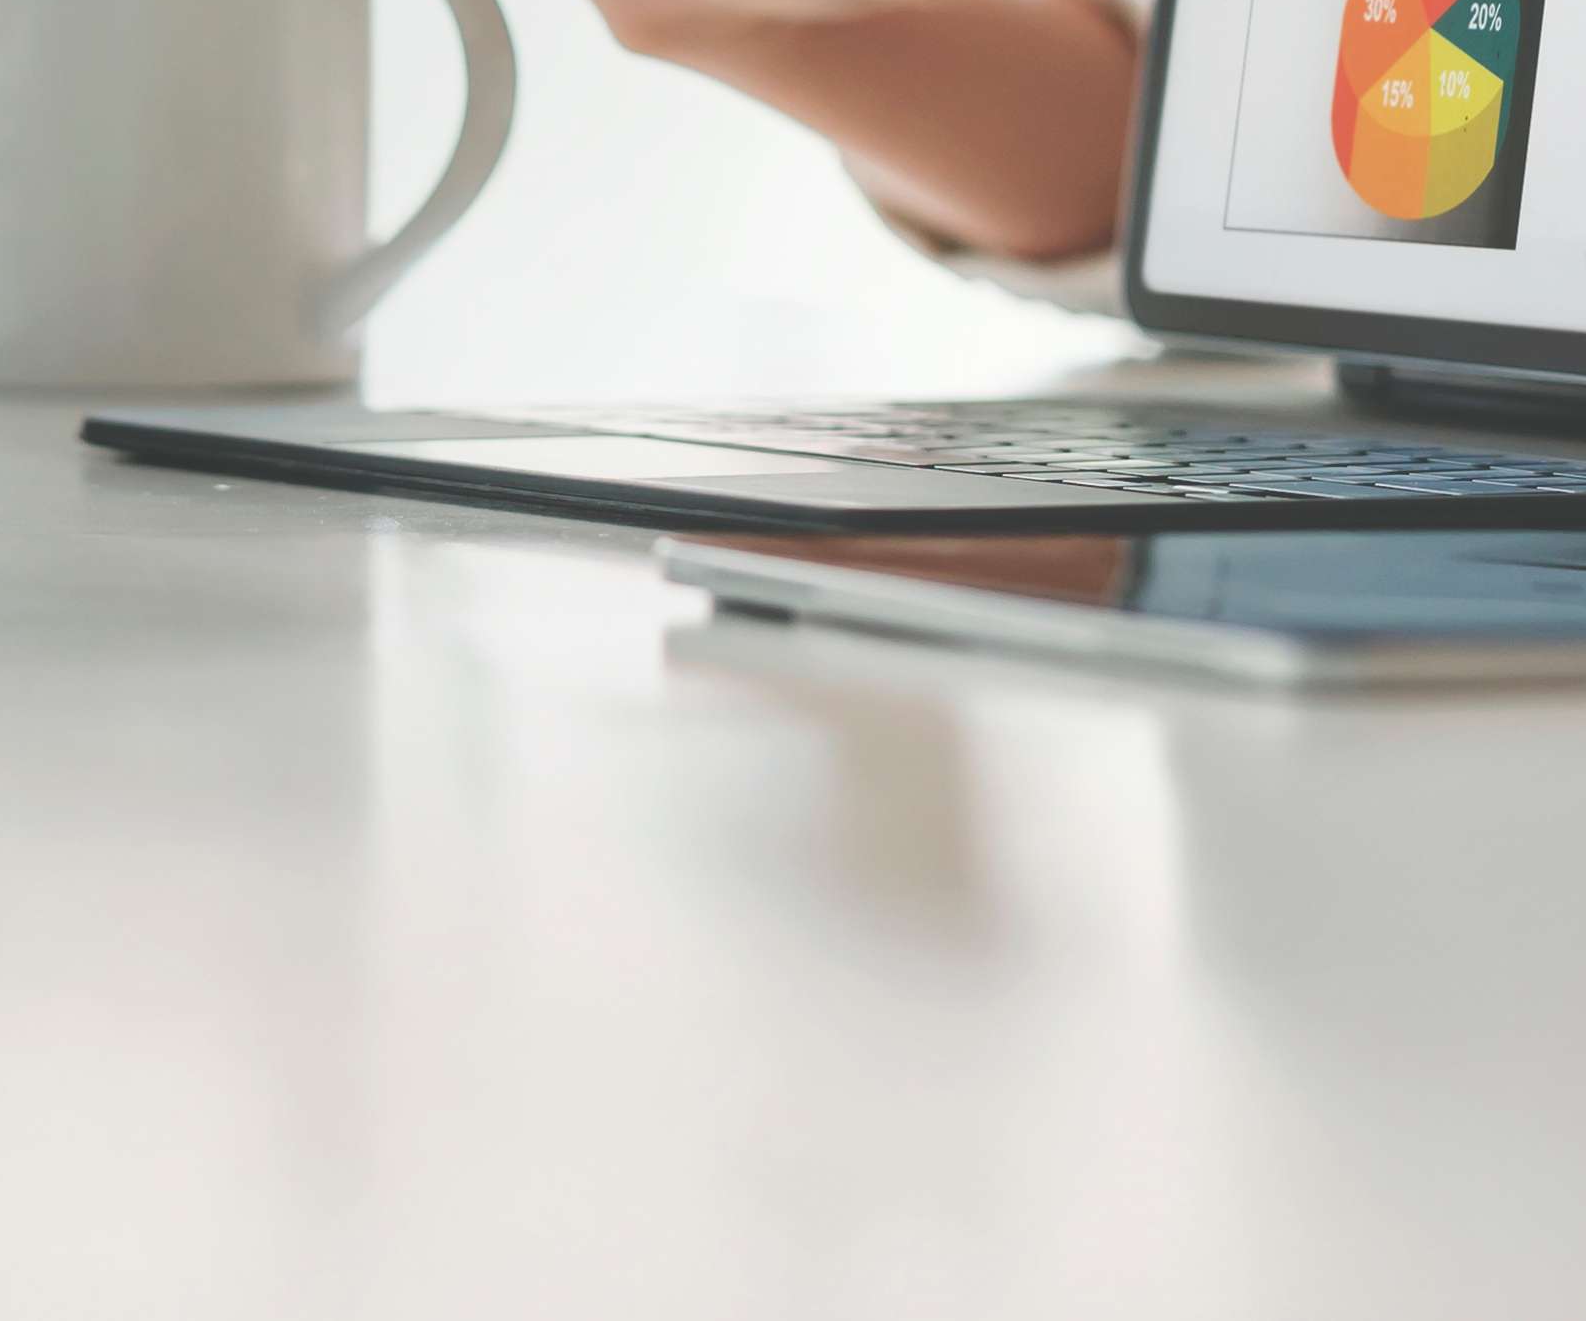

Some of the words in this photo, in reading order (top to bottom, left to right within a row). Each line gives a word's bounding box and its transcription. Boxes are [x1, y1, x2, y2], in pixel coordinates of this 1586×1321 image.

[1468, 2, 1502, 31] 20%
[1382, 80, 1414, 109] 15%
[1439, 70, 1471, 99] 10%
